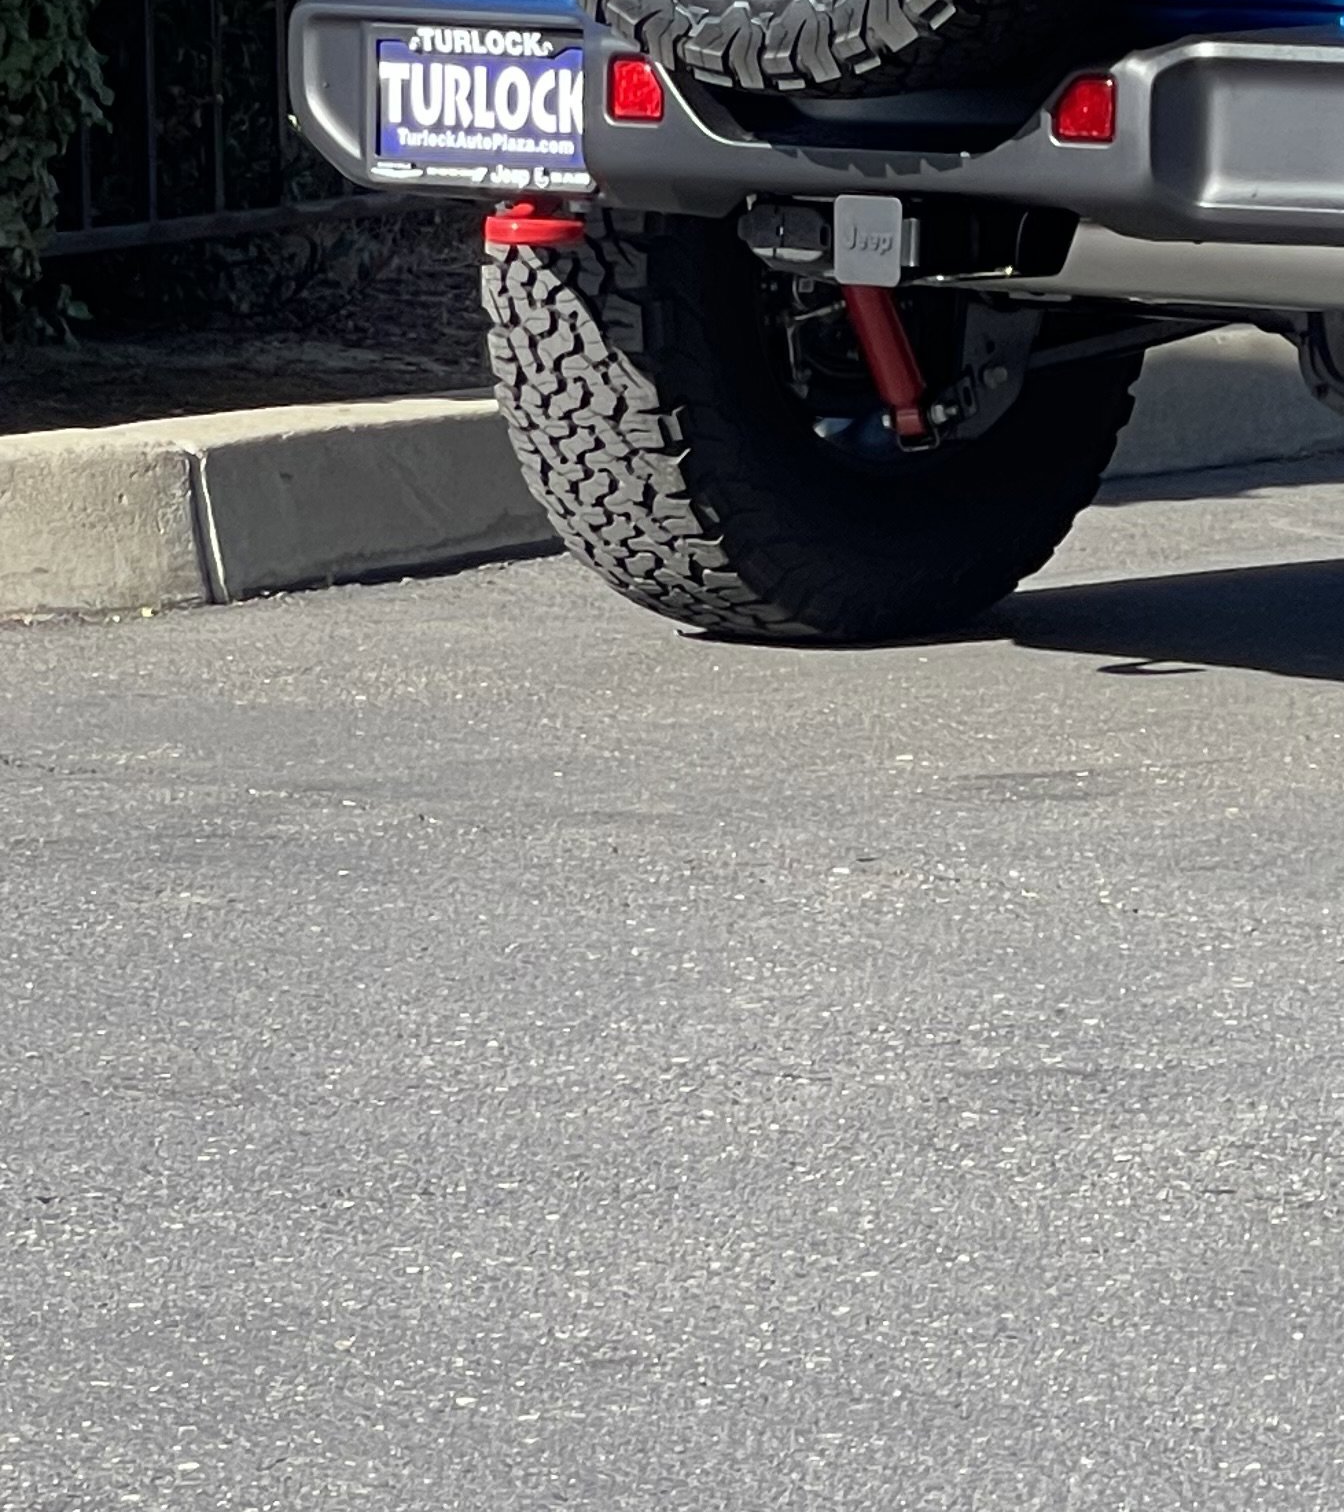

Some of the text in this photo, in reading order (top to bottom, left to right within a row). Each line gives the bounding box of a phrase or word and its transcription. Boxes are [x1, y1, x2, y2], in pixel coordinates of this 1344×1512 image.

[416, 26, 544, 56] TURLOCK
[379, 61, 584, 135] TURLOCK
[397, 128, 576, 156] TurlockAutoPlaza.com
[846, 225, 894, 256] Jeep
